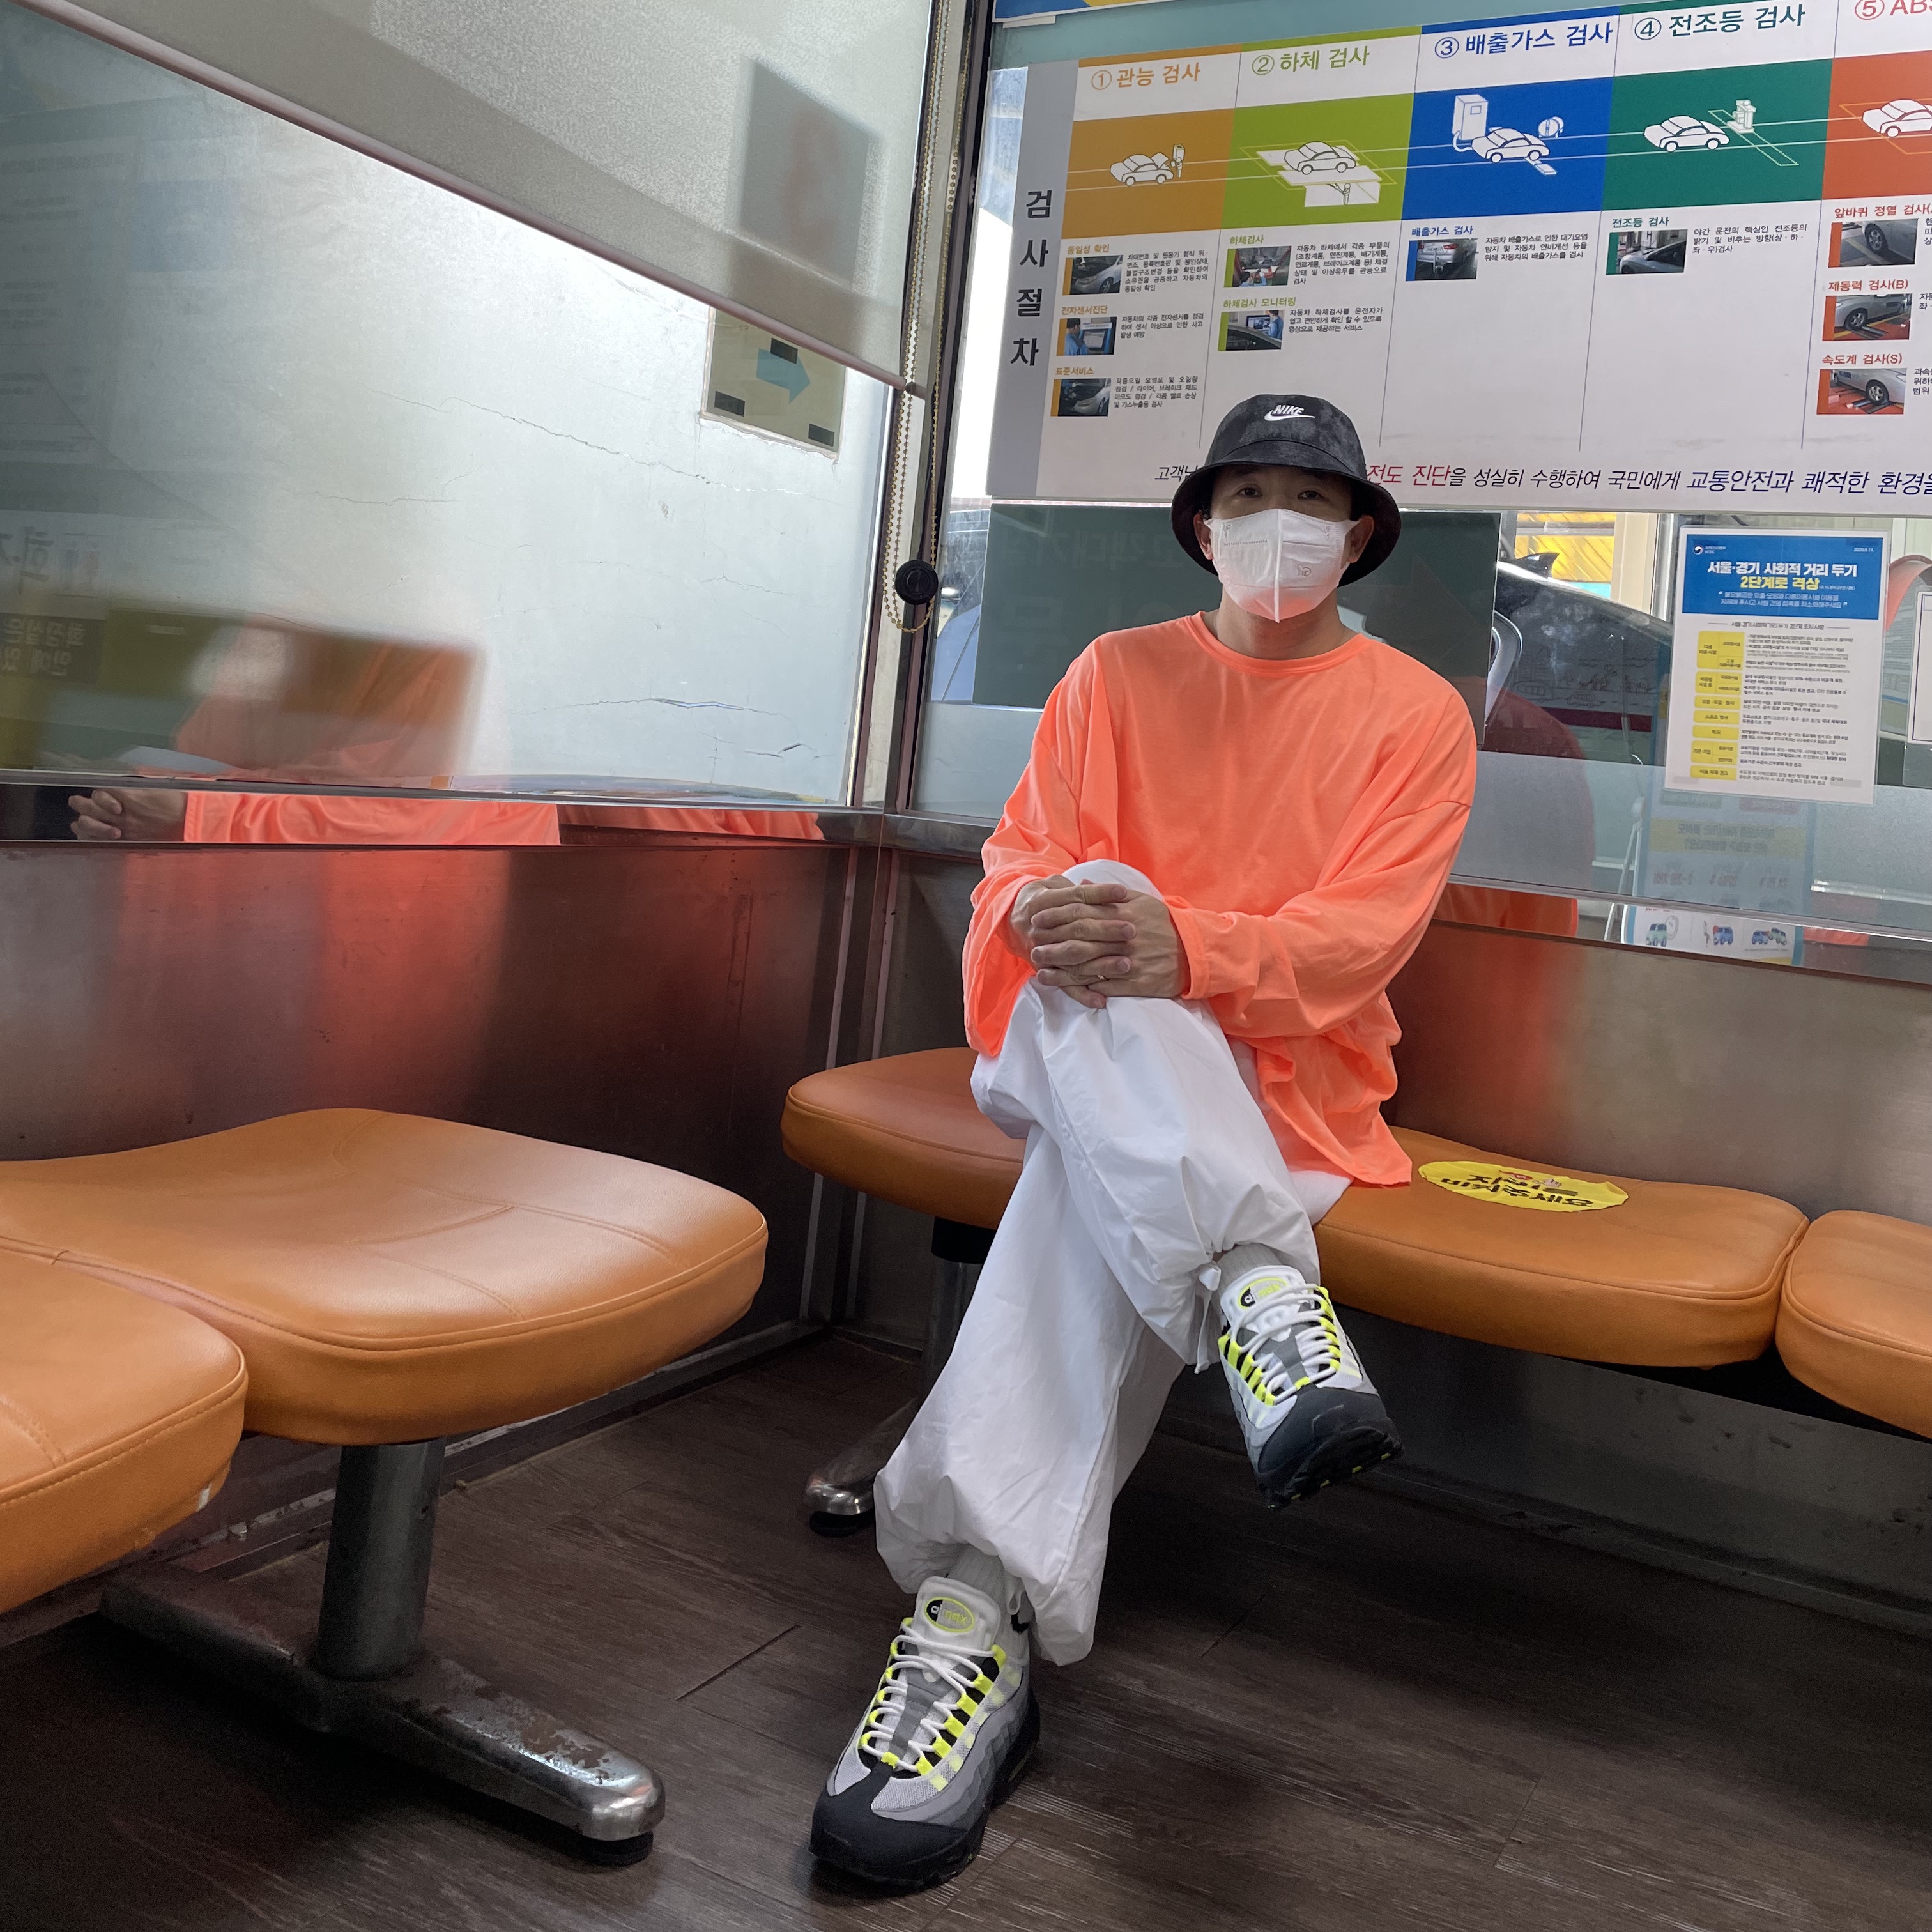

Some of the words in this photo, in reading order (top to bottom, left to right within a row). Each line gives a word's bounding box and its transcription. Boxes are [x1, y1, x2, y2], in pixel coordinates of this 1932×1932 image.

[1890, 0, 1932, 15] AB
[1669, 9, 1745, 38] 전조등
[1755, 3, 1805, 32] 검사
[1466, 29, 1556, 56] 배출가스
[1566, 20, 1613, 47] 검사
[1280, 51, 1320, 72] 하체
[1328, 45, 1370, 68] 검사
[1116, 68, 1154, 88] 관능
[1163, 62, 1201, 84] 검사
[1835, 207, 1867, 218] 앞바퀴
[1874, 205, 1897, 216] 정열
[1903, 203, 1932, 215] 검사(
[1613, 218, 1643, 228] 전조등
[1649, 217, 1669, 227] 검사
[1775, 224, 1807, 233] 전조등의
[1411, 227, 1449, 236] 배출가스
[1455, 225, 1473, 235] 검사
[1230, 235, 1264, 245] 하체검사
[1715, 236, 1722, 244] 및
[1728, 235, 1751, 244] 비추는
[1067, 245, 1090, 254] 동일성
[1094, 243, 1109, 252] 확인
[1531, 252, 1565, 260] 배출가스를
[1322, 267, 1354, 275] 이상유무를
[1828, 280, 1862, 291] 제동력
[1869, 279, 1908, 290] 검사(B)
[1223, 298, 1257, 308] 하체검사
[1261, 296, 1296, 307] 모니터링
[1062, 305, 1108, 315] 전자센서진단
[1822, 355, 1857, 365] 속도계
[1863, 353, 1902, 364] 검사(S)
[1055, 367, 1094, 376] 표준서비스
[1273, 404, 1305, 415] NIKE
[1365, 464, 1402, 486] 전도
[1412, 464, 1466, 487] 진단을
[1473, 468, 1524, 488] 성실히
[1529, 469, 1600, 490] 수행하여
[1608, 470, 1682, 491] 국민에게
[1686, 471, 1794, 493] 교통안전과
[1802, 471, 1870, 494] 쾌적한
[1707, 561, 1761, 575] 서울·경기
[1764, 562, 1801, 575] 사회적
[1803, 564, 1828, 576] 거리
[1831, 565, 1857, 578] 두기
[1740, 576, 1788, 589] 2단계로
[1792, 578, 1820, 590] 격상
